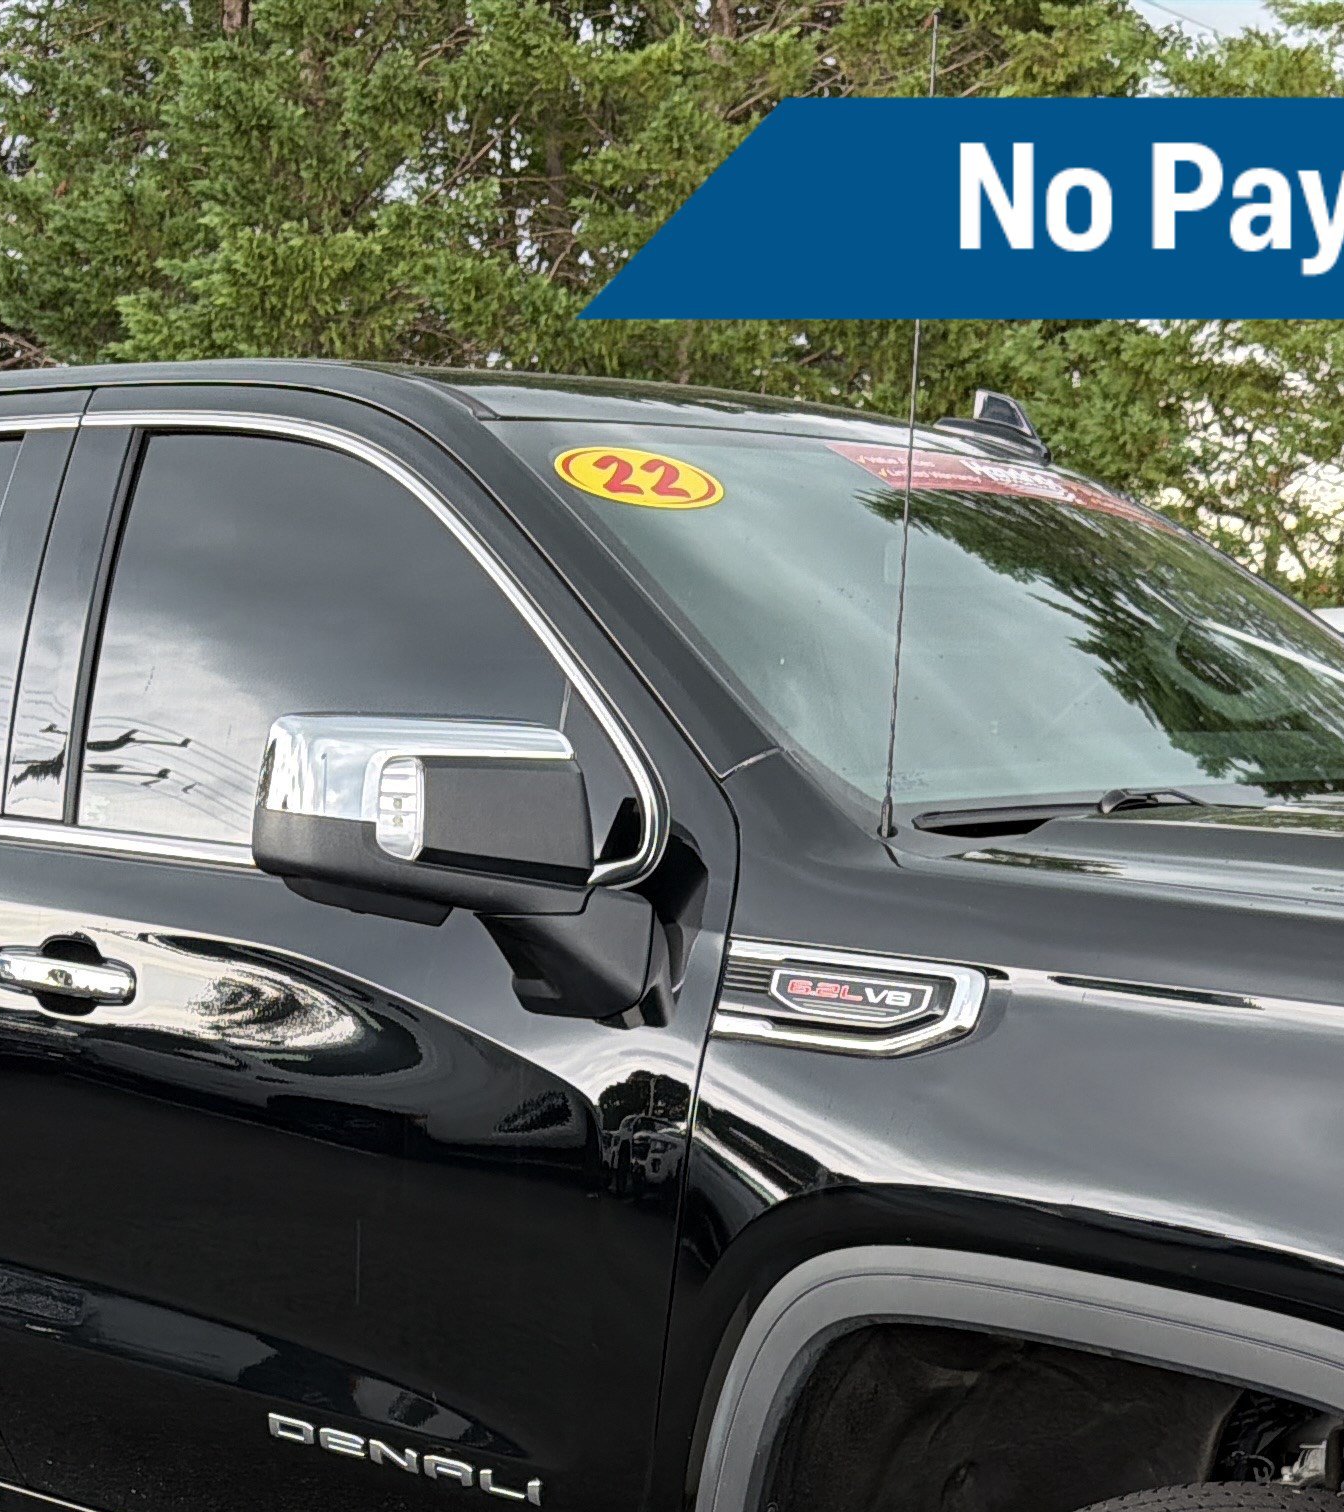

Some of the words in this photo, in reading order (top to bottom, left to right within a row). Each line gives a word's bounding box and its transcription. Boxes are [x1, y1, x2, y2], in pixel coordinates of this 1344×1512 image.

[592, 455, 691, 498] 22
[787, 979, 863, 1002] 6.2L
[864, 987, 912, 1007] V8
[268, 1412, 541, 1506] DENALI
